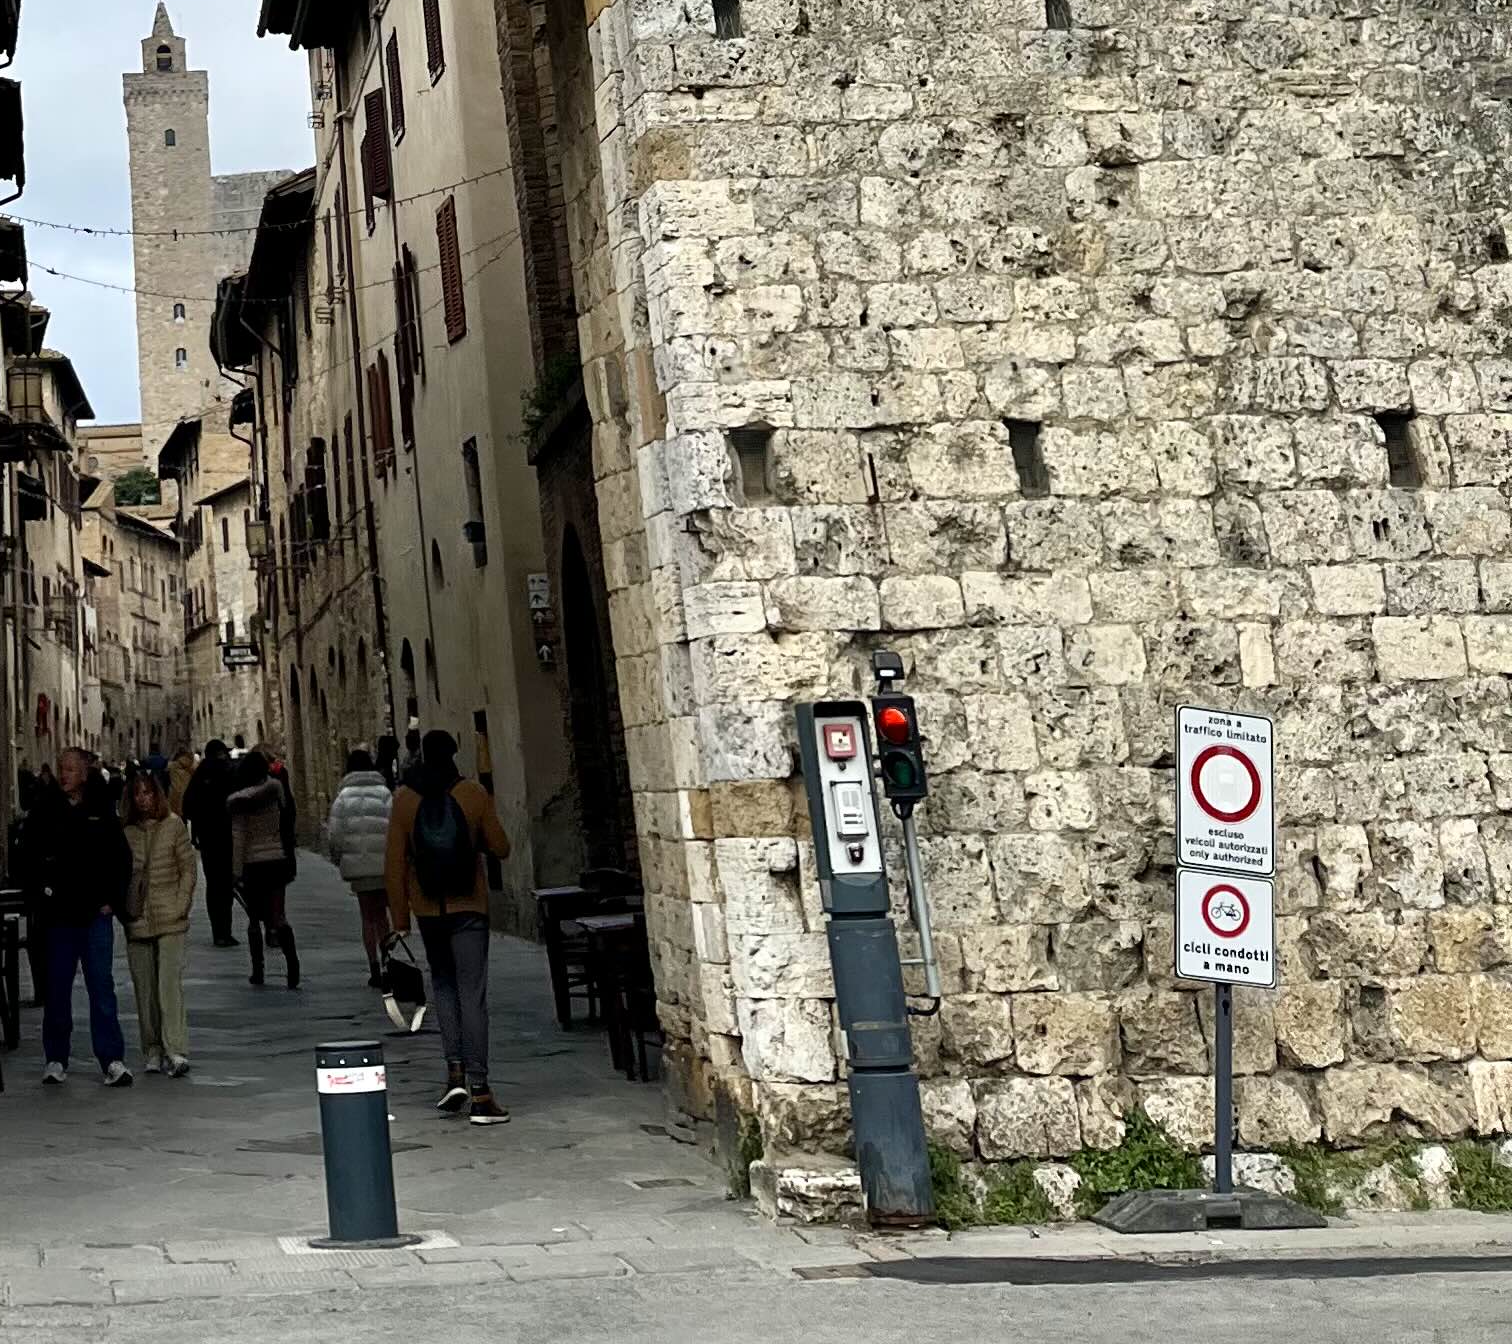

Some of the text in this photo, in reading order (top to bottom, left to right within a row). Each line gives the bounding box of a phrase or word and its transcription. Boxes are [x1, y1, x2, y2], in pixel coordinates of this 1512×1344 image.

[1208, 716, 1242, 728] zona a
[1184, 724, 1267, 743] traffico limitato
[1208, 829, 1244, 839] escluso
[1185, 837, 1268, 854] veicoli autorizzati
[1189, 849, 1263, 866] only authorized
[1184, 941, 1269, 962] cicli condotti
[1203, 961, 1249, 974] a mano
